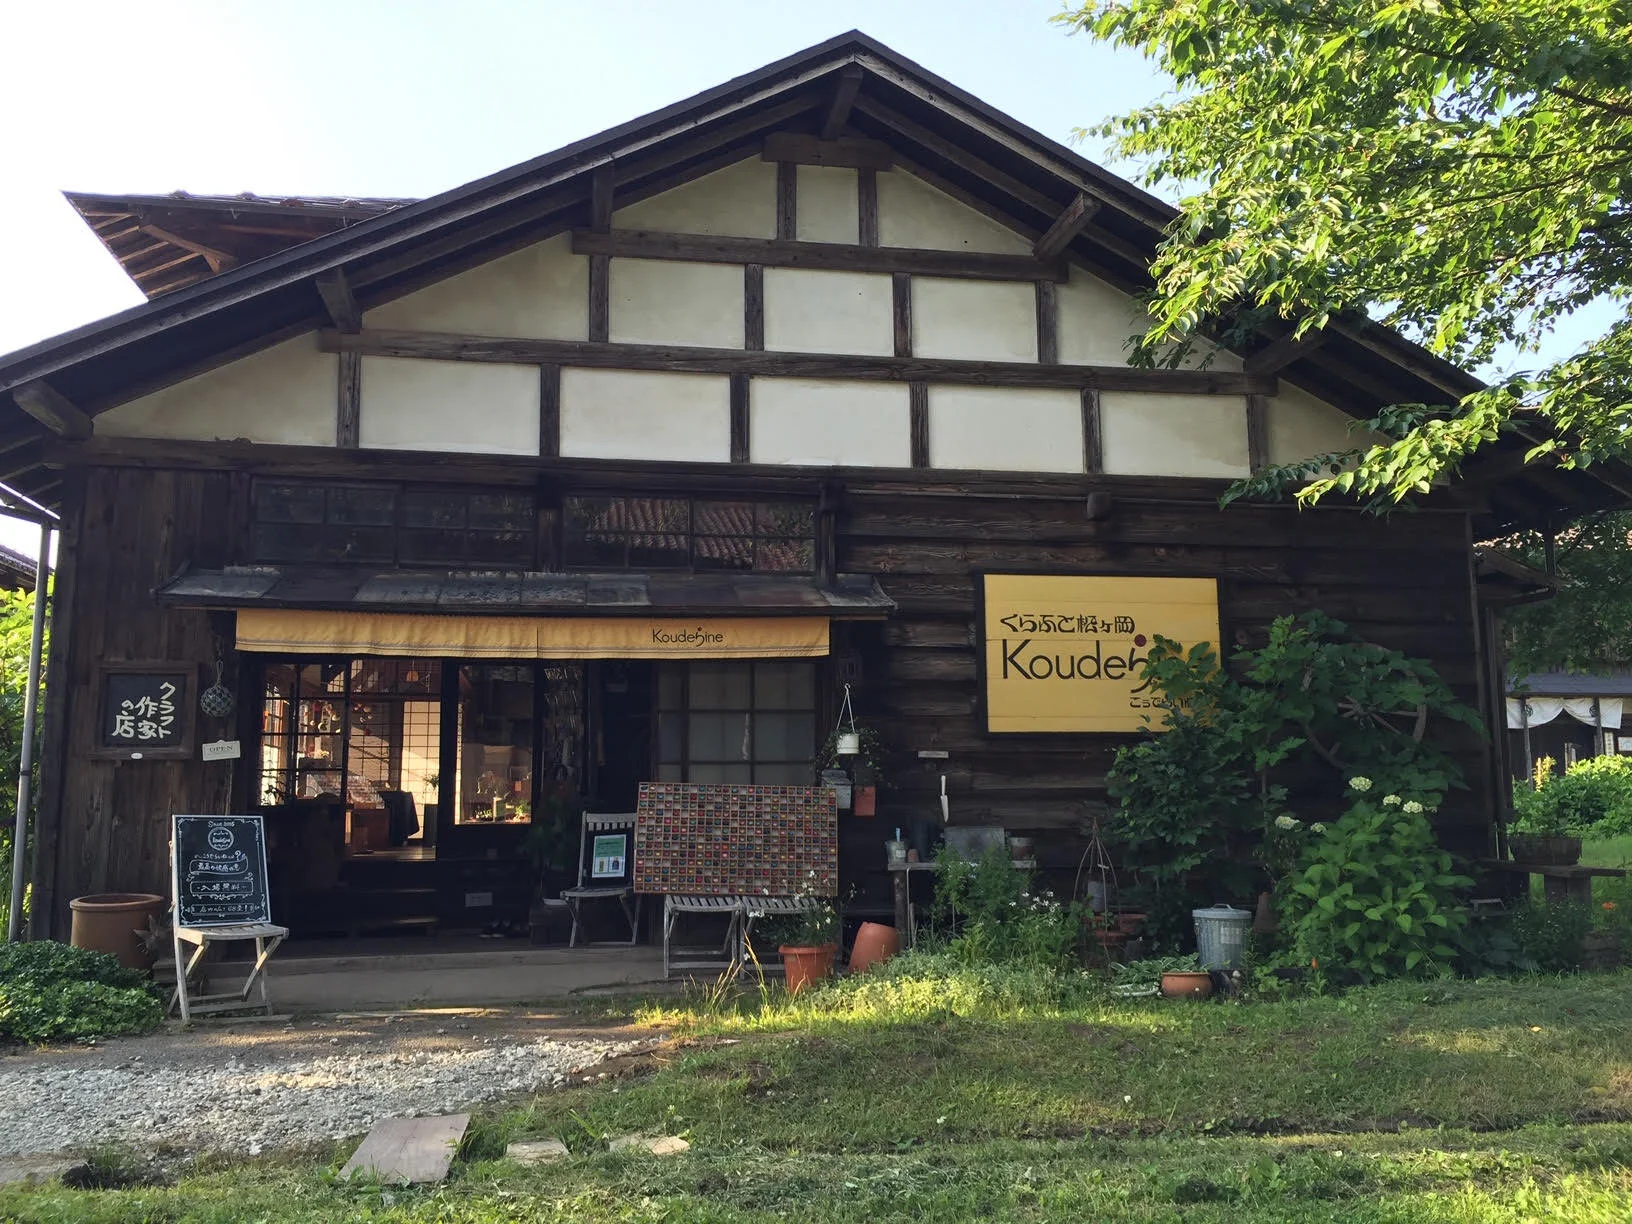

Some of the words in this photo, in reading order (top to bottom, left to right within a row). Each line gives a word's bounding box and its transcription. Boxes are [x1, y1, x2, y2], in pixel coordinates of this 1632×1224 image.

[112, 699, 136, 739] の店
[134, 696, 159, 740] 作家
[157, 682, 177, 739] クラフト
